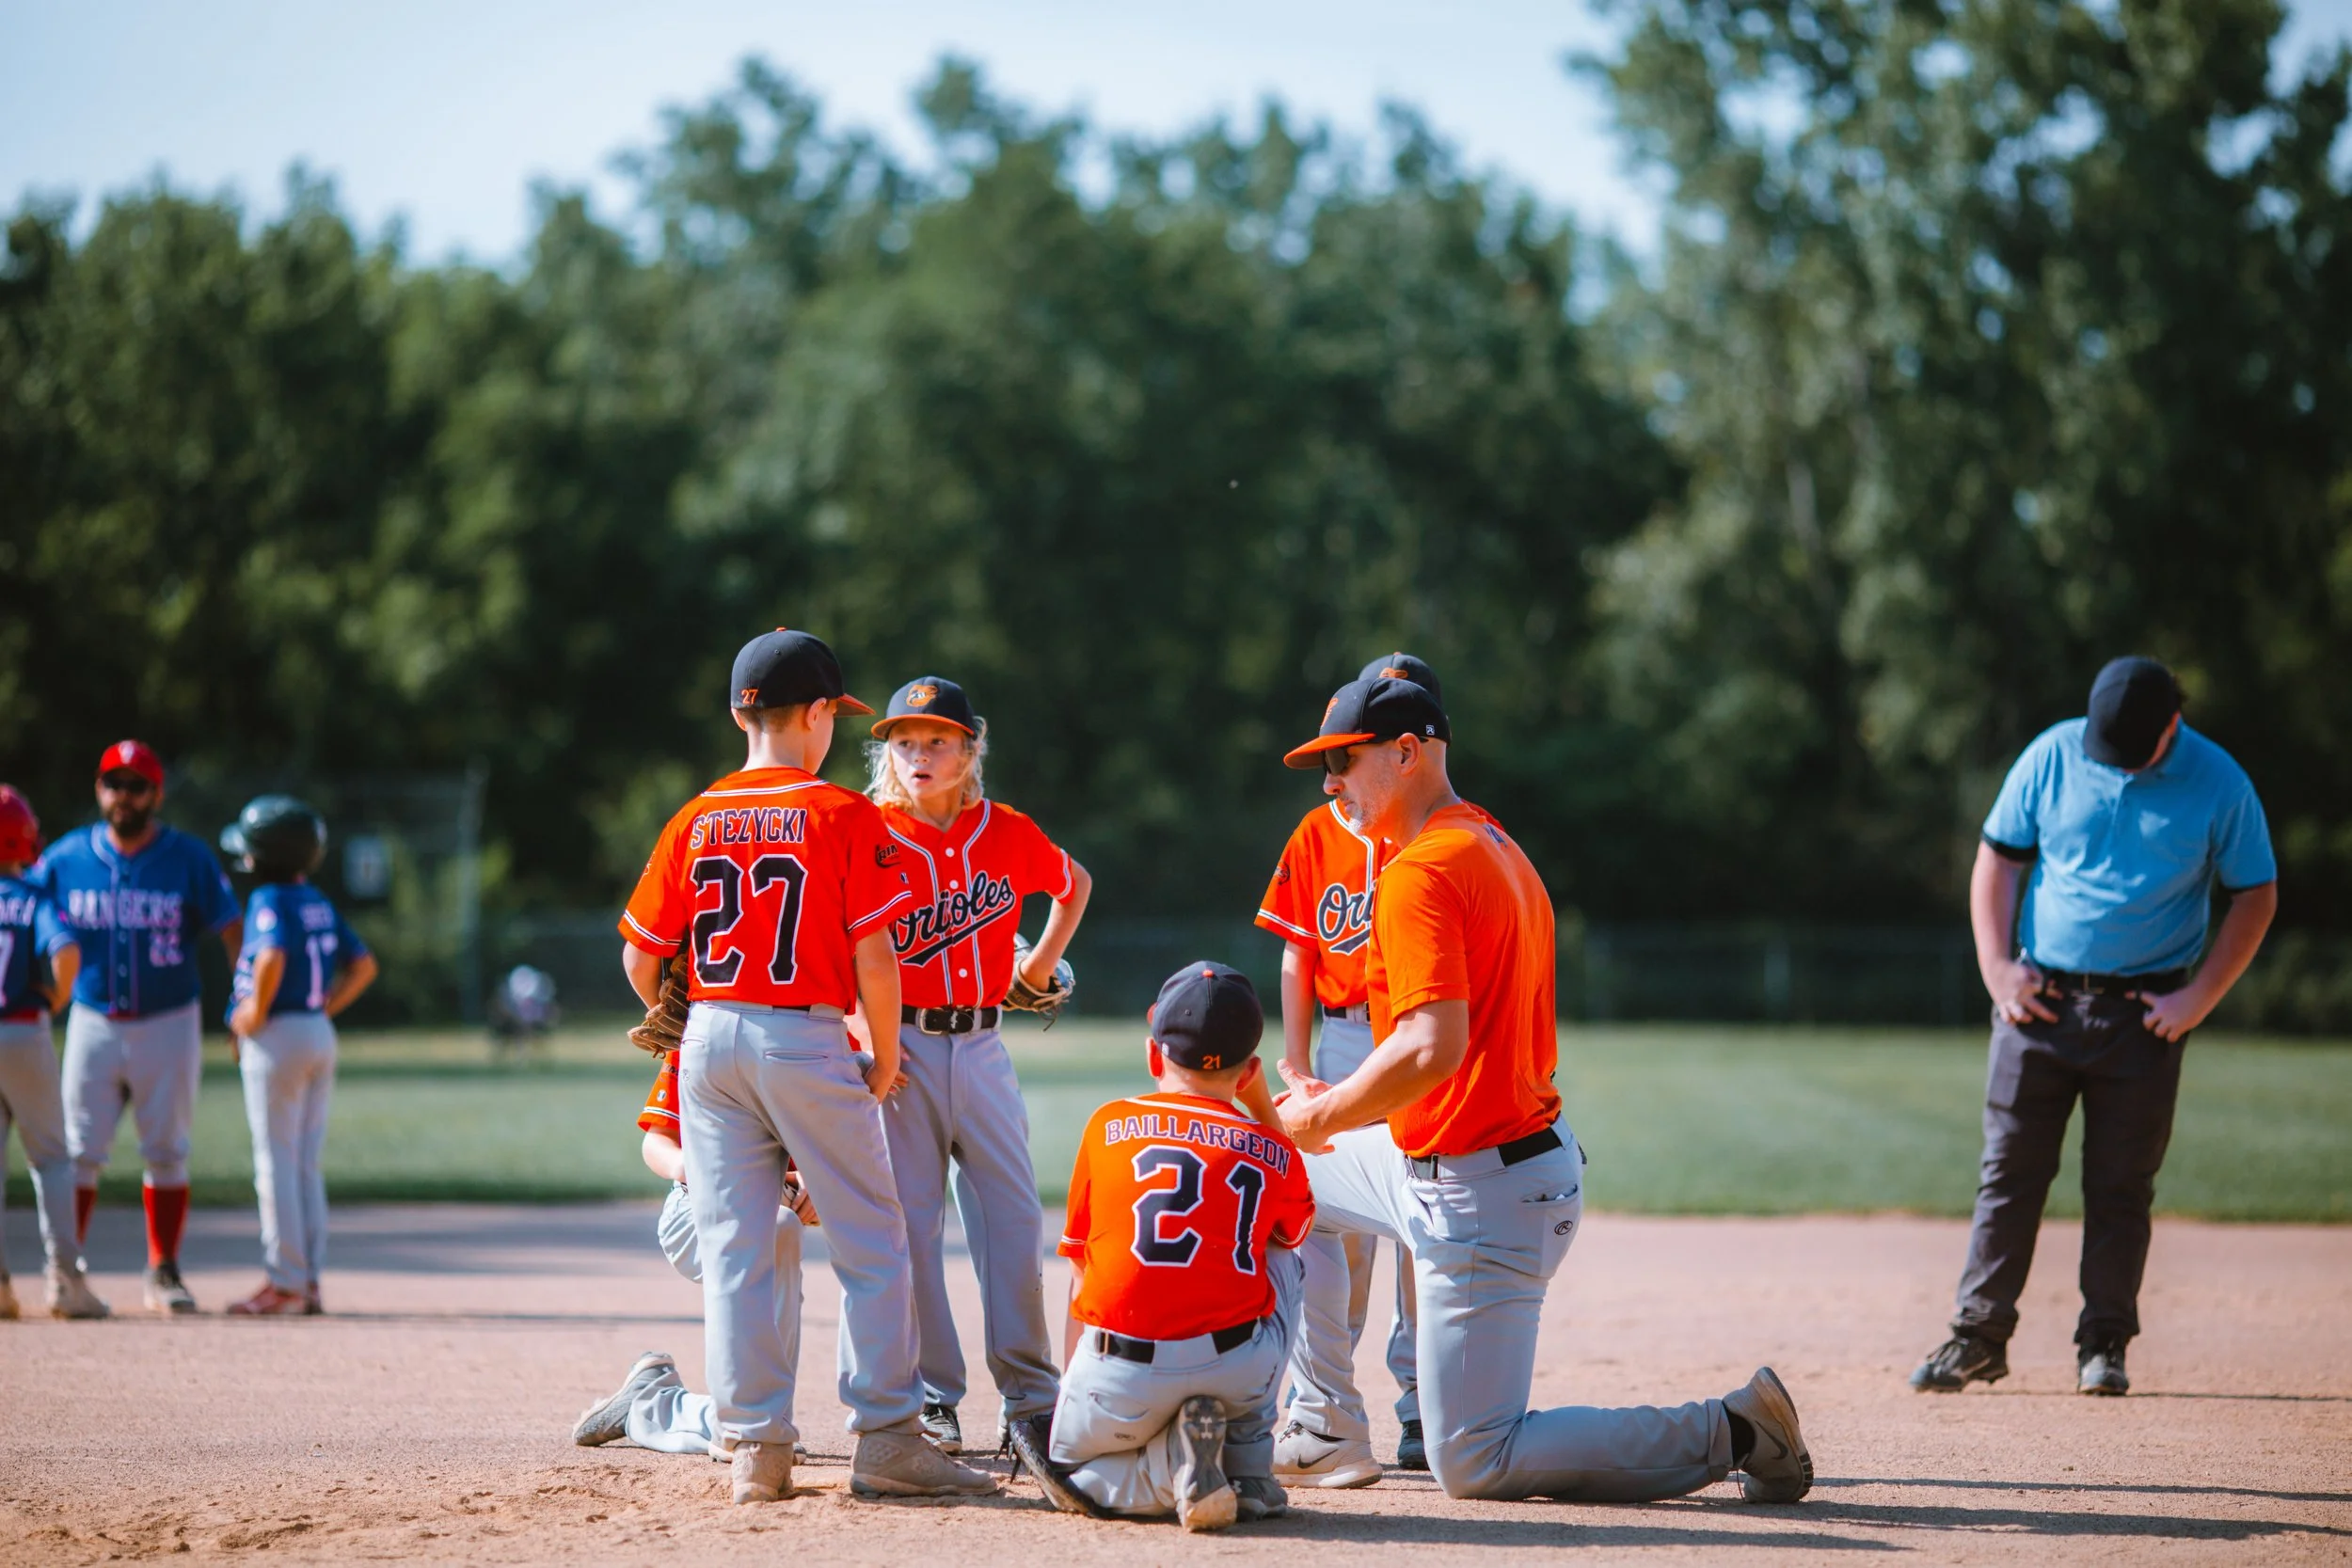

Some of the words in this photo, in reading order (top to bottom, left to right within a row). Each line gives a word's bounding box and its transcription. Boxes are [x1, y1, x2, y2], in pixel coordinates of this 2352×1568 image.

[741, 689, 758, 705] 27
[691, 806, 807, 849] STEZYCKI
[68, 889, 182, 929] RANGERS
[690, 853, 808, 988] 27
[892, 870, 1015, 954] Orioles
[1202, 1054, 1221, 1069] 21
[1105, 1114, 1290, 1179] BAILLARGEON
[1130, 1144, 1265, 1276] 21
